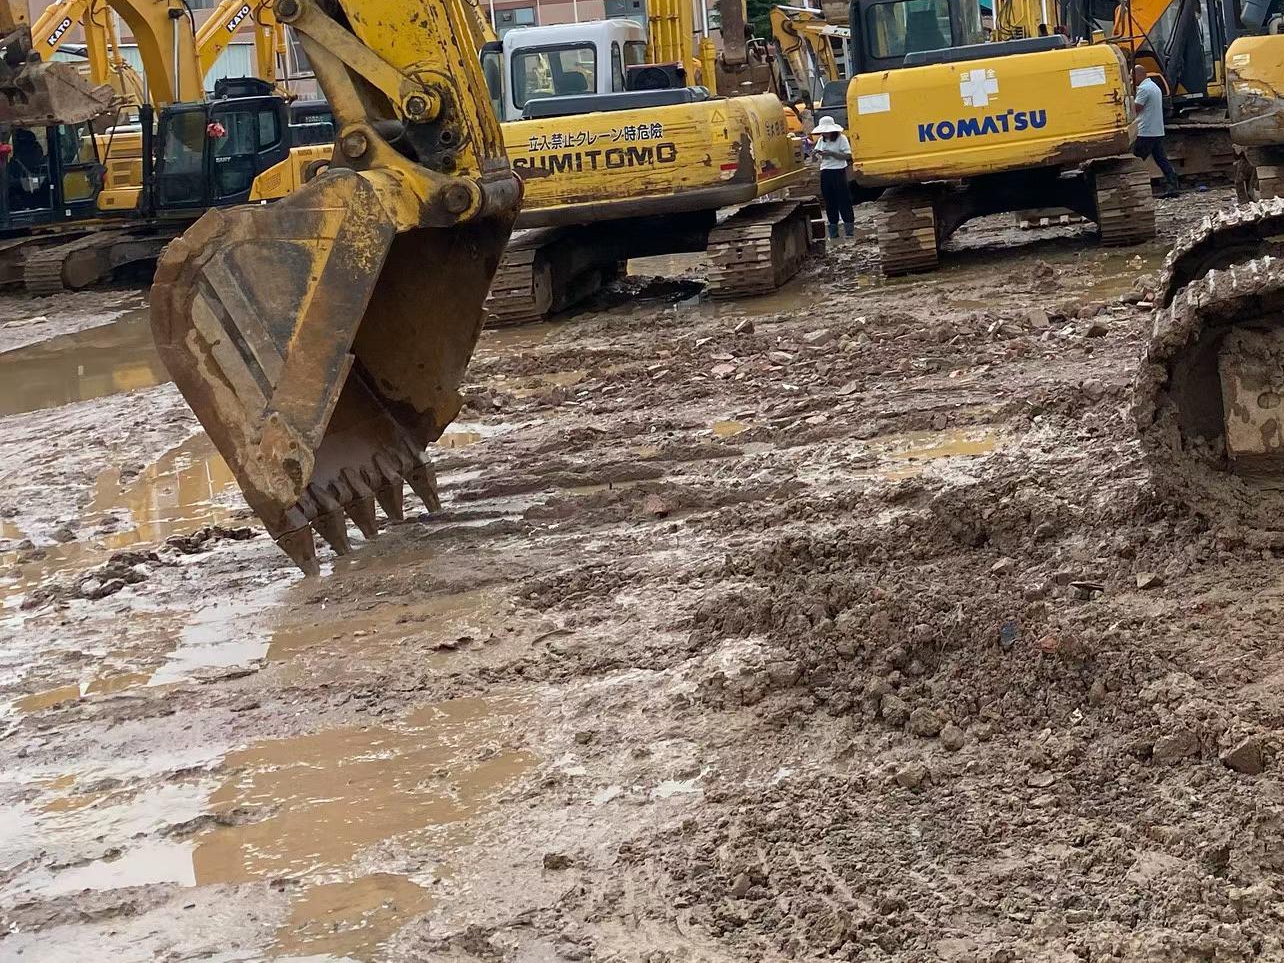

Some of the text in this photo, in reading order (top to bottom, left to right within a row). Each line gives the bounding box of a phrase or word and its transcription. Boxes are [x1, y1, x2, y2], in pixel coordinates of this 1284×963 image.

[48, 18, 71, 46] KATO
[227, 6, 250, 31] KATO
[918, 109, 1047, 143] KOMATSU
